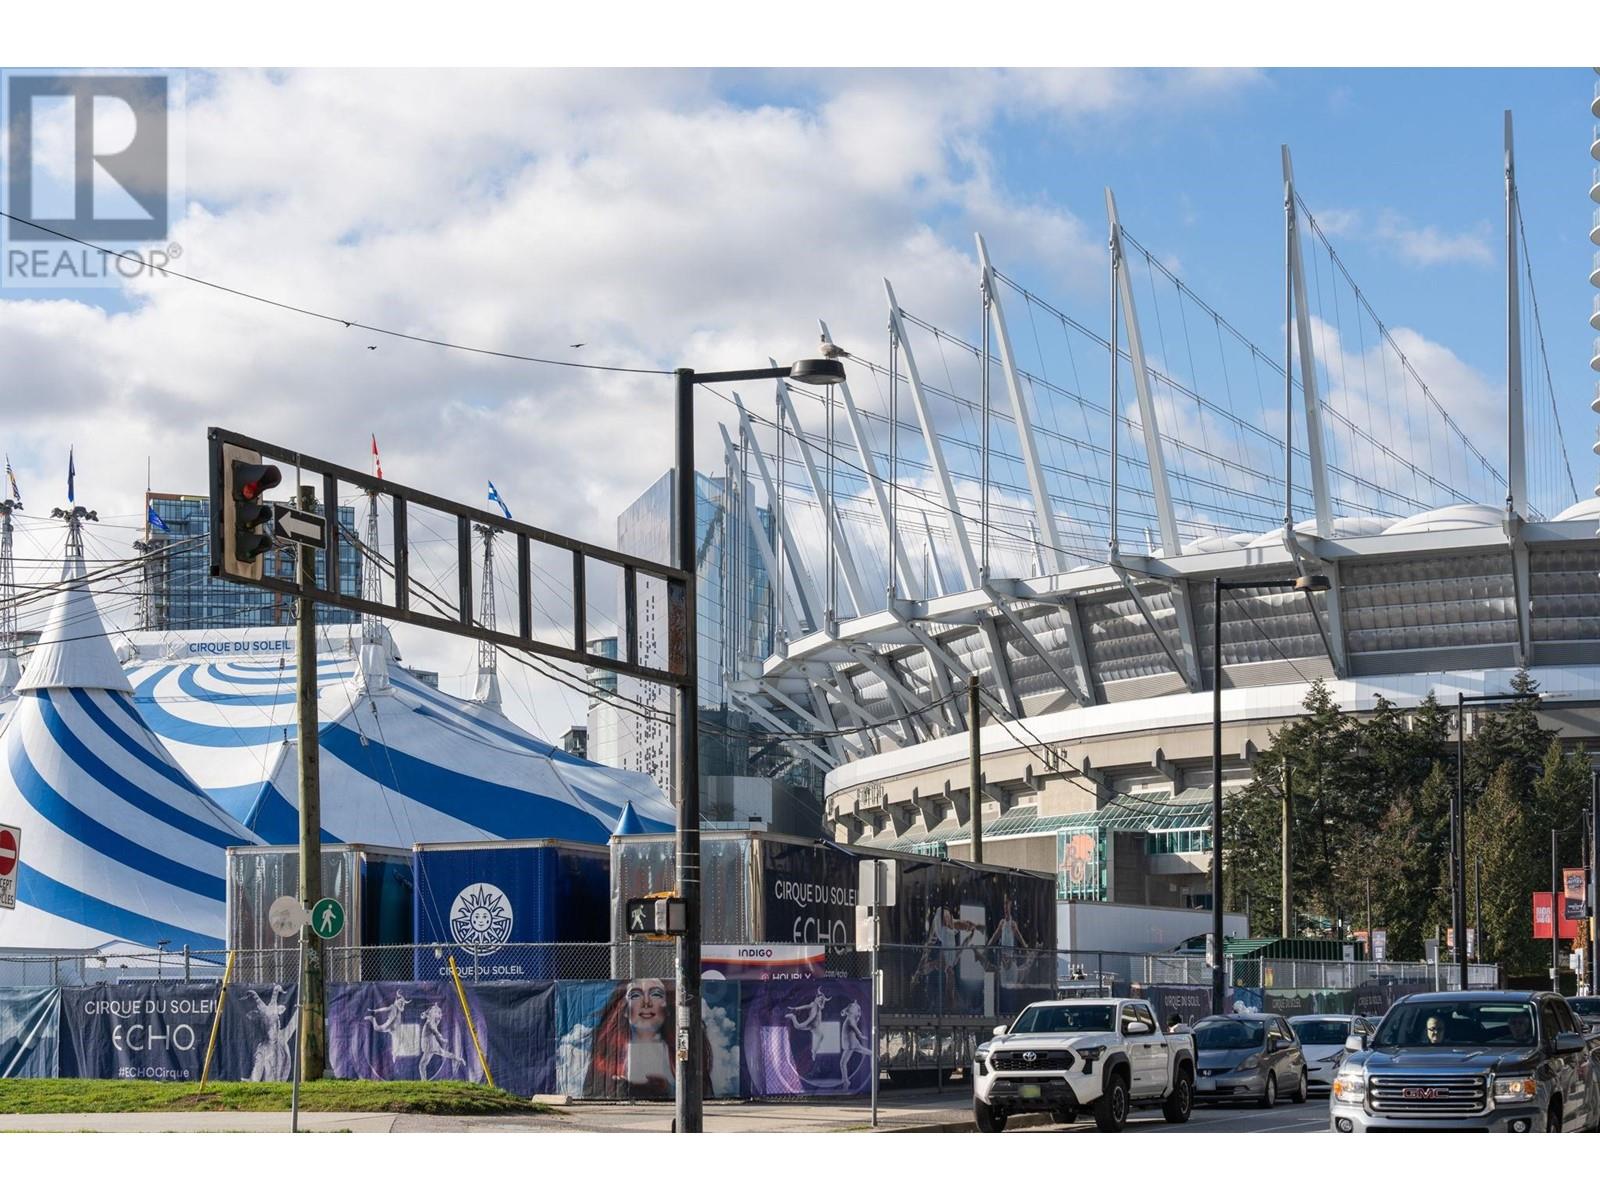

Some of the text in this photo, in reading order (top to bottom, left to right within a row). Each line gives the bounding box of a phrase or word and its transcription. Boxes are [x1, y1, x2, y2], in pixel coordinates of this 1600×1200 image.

[189, 640, 291, 655] CIRQUE DU SOLEIL
[775, 880, 857, 908] CIRQUE DU SOLEI
[793, 916, 847, 955] ECHO
[738, 949, 773, 958] INDIGO
[492, 965, 525, 975] SOLEIL
[84, 1000, 141, 1019] CIRQUE
[145, 1000, 166, 1014] DU
[112, 1024, 195, 1051] ECHO
[118, 1066, 190, 1080] #ECHOCirque
[1402, 1087, 1449, 1099] GMC
